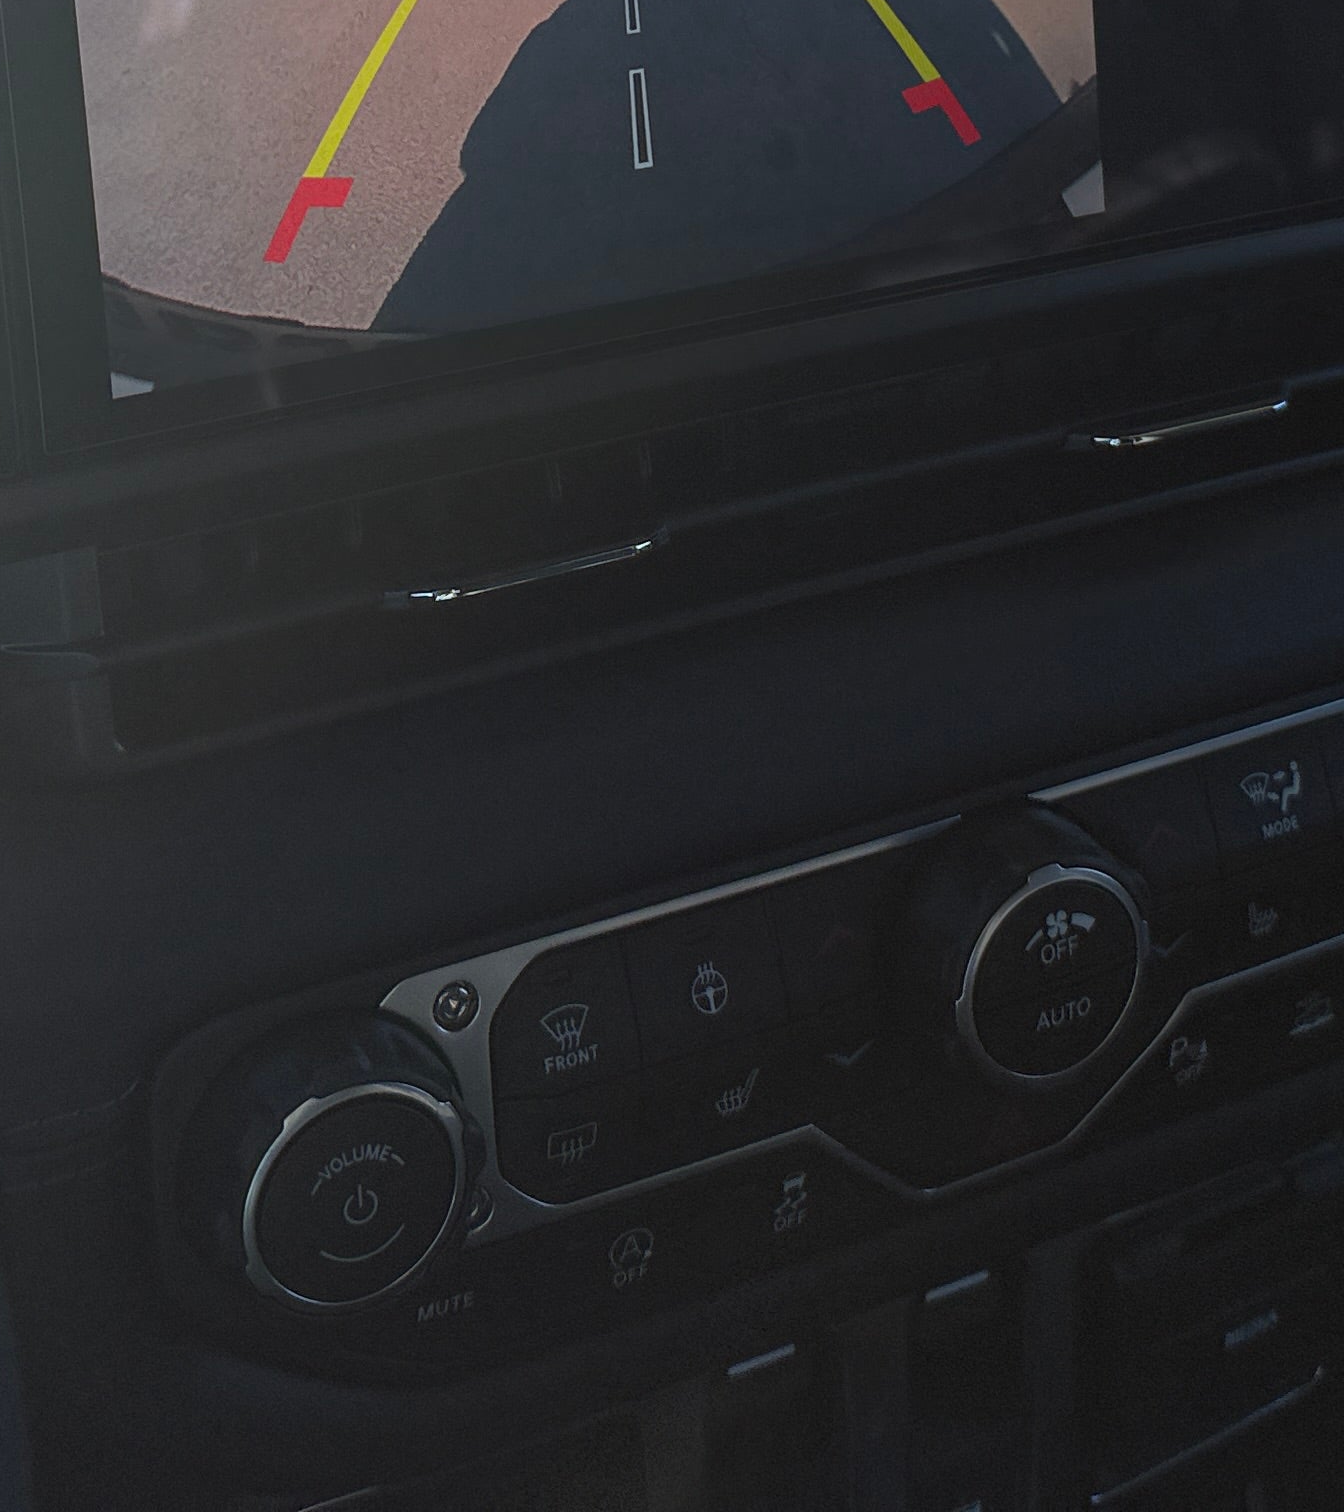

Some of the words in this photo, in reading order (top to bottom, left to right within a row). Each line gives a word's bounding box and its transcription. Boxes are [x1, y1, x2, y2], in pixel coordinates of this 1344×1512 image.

[1261, 815, 1300, 840] MODE
[1040, 934, 1079, 965] OFF
[1035, 995, 1092, 1032] AUTO
[543, 1043, 601, 1074] FRONT
[318, 1143, 393, 1182] VOLUME
[773, 1213, 805, 1234] OFF
[613, 1265, 649, 1288] OFF
[416, 1290, 475, 1324] MUTE
